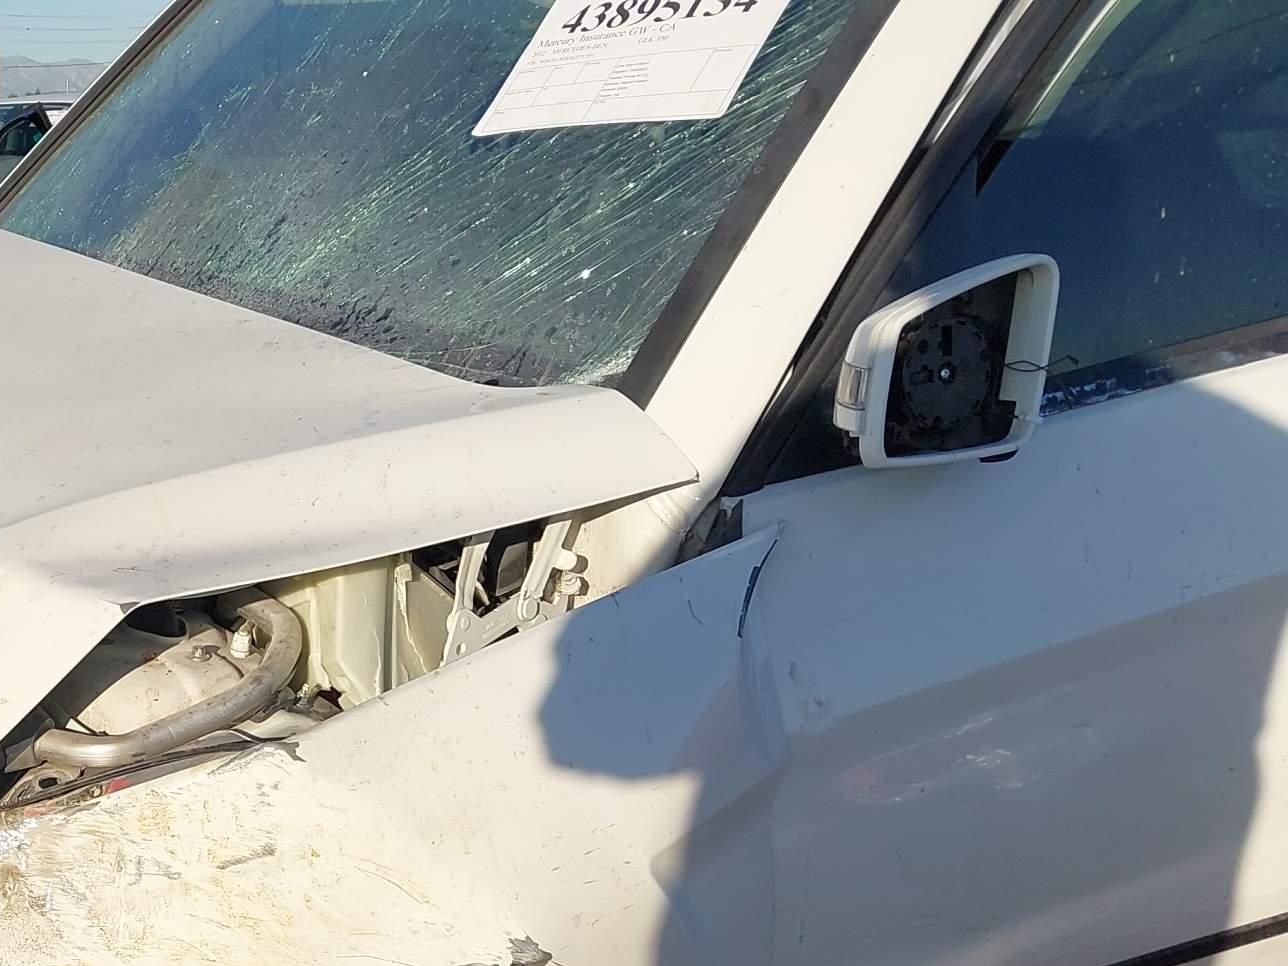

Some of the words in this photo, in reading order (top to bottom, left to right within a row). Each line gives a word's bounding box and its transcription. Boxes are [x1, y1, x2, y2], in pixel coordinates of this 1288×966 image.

[538, 35, 576, 49] Mercury
[579, 29, 626, 43] Insurance
[628, 25, 651, 36] GW
[659, 23, 677, 33] CA
